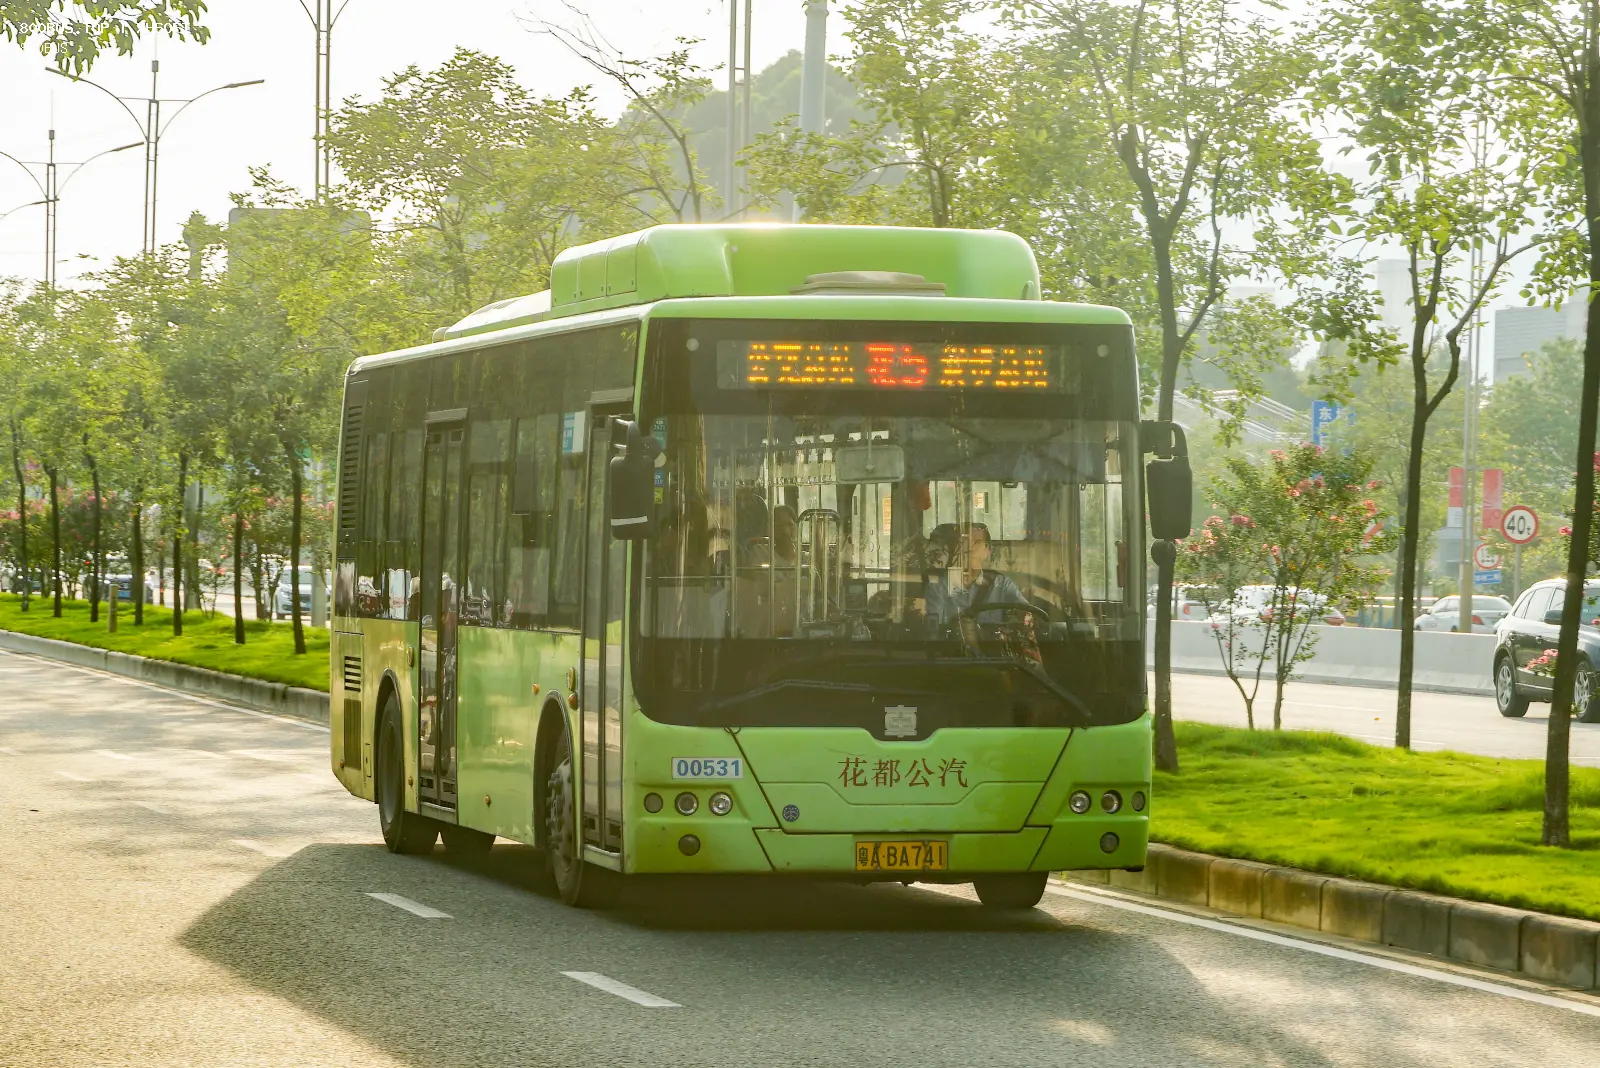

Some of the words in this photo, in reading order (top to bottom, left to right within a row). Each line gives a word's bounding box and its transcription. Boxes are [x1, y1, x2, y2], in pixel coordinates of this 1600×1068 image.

[676, 759, 740, 777] 00531
[837, 756, 968, 788] 花都公汽
